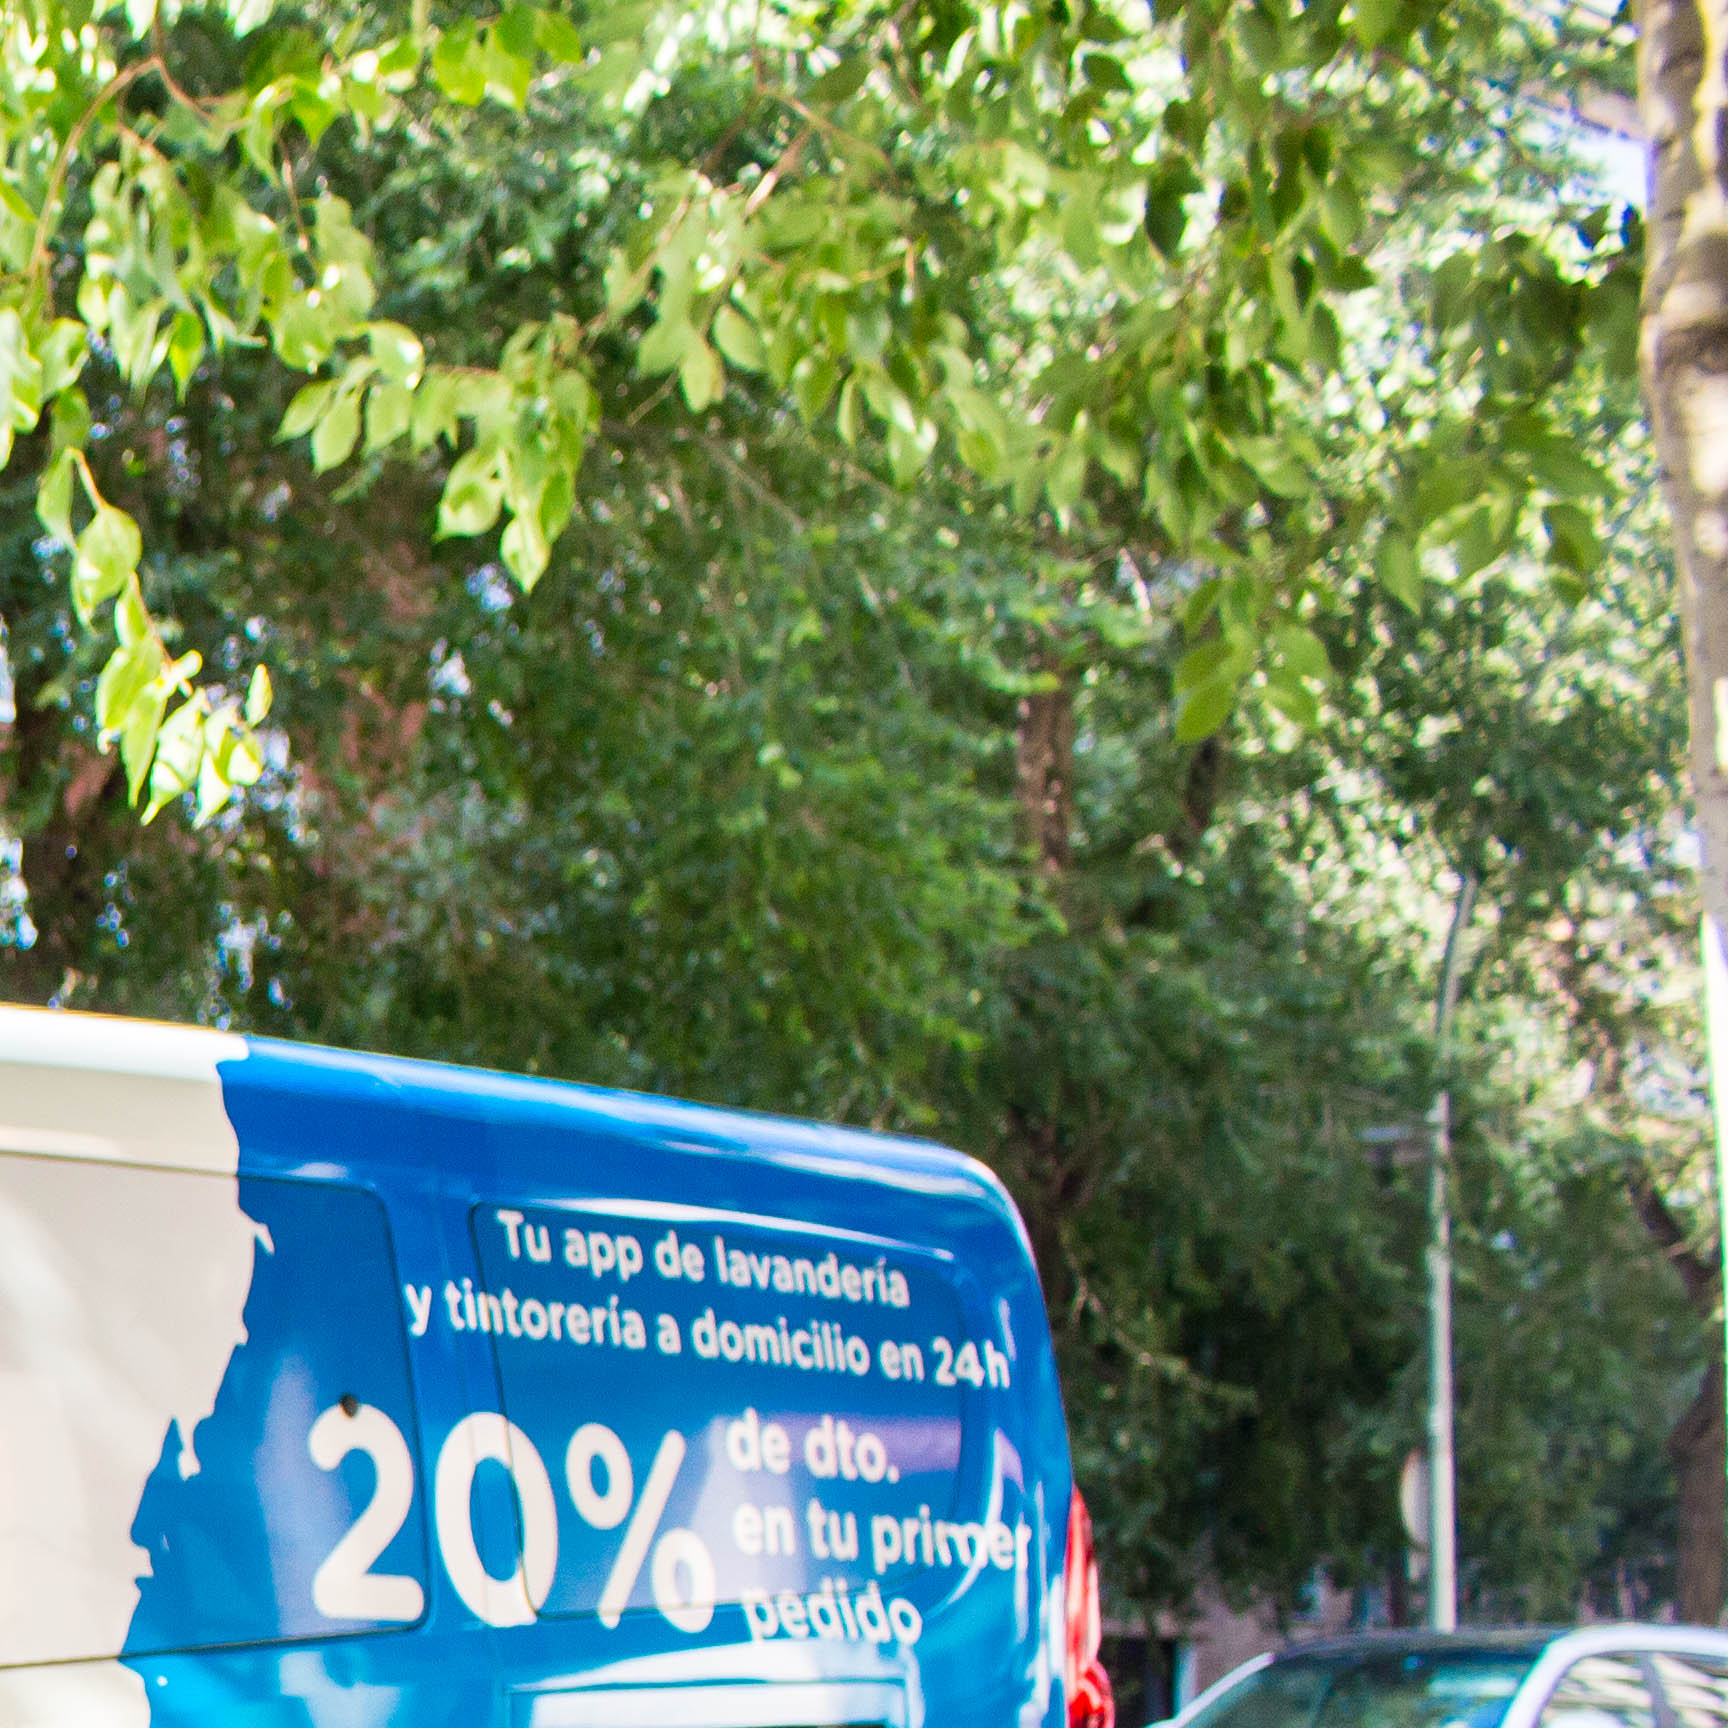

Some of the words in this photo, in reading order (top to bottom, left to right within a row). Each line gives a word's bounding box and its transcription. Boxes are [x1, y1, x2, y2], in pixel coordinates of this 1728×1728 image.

[496, 1208, 553, 1264] Tu
[563, 1228, 645, 1283] app
[654, 1229, 706, 1283] de
[714, 1234, 911, 1309] lavandería
[403, 1283, 434, 1338] y
[444, 1276, 648, 1350] tintorería
[656, 1312, 683, 1355] a
[691, 1305, 872, 1377] domicilio
[879, 1339, 926, 1382] en
[932, 1335, 1011, 1390] 24h
[726, 1406, 792, 1475] de
[803, 1413, 901, 1485] dto.
[307, 1402, 716, 1634] 20%
[732, 1503, 796, 1556] en
[806, 1497, 860, 1561] tu
[871, 1503, 1034, 1576] primer
[741, 1575, 924, 1645] pedido
